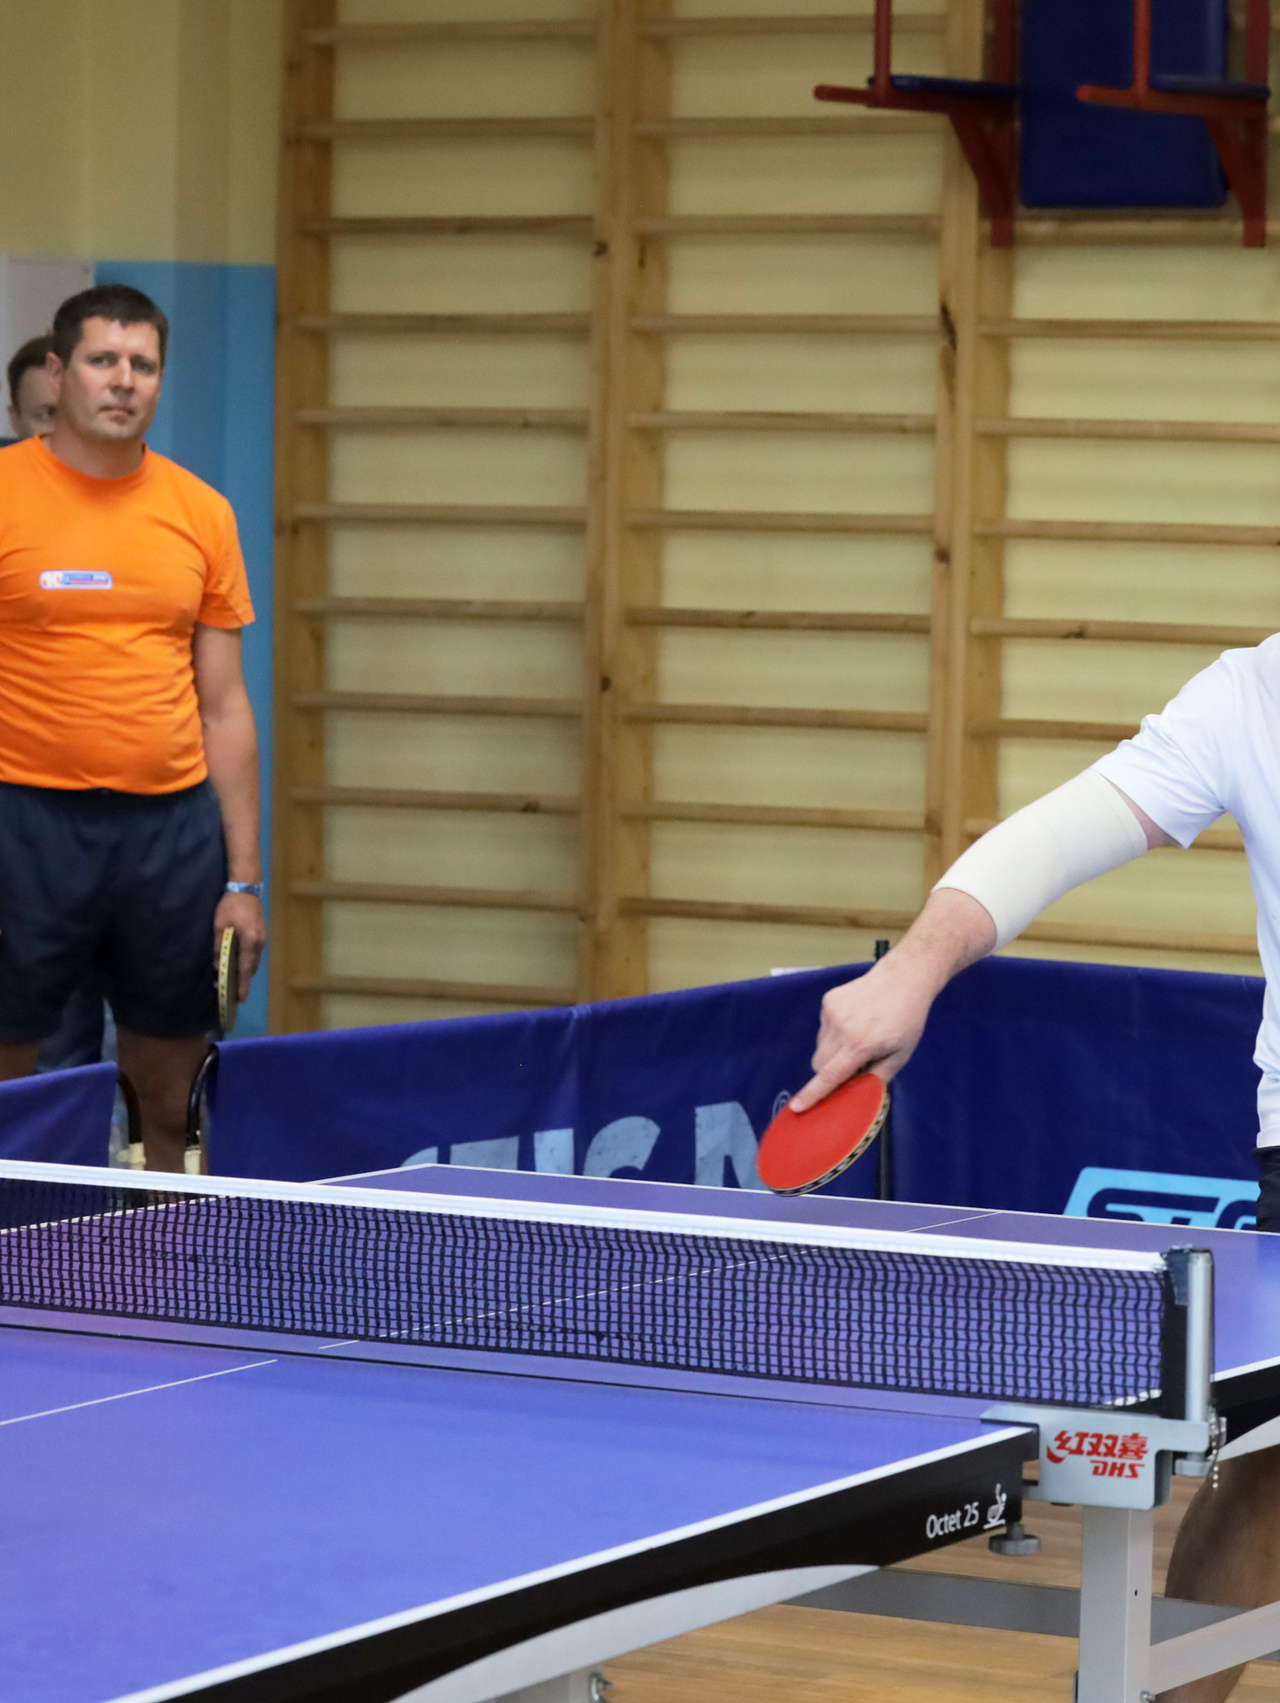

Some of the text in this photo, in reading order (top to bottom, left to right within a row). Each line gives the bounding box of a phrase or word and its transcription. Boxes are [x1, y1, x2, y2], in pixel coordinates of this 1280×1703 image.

[1046, 1430, 1149, 1464] 红双喜
[1090, 1459, 1146, 1479] DHS
[926, 1501, 980, 1539] Octet 25
